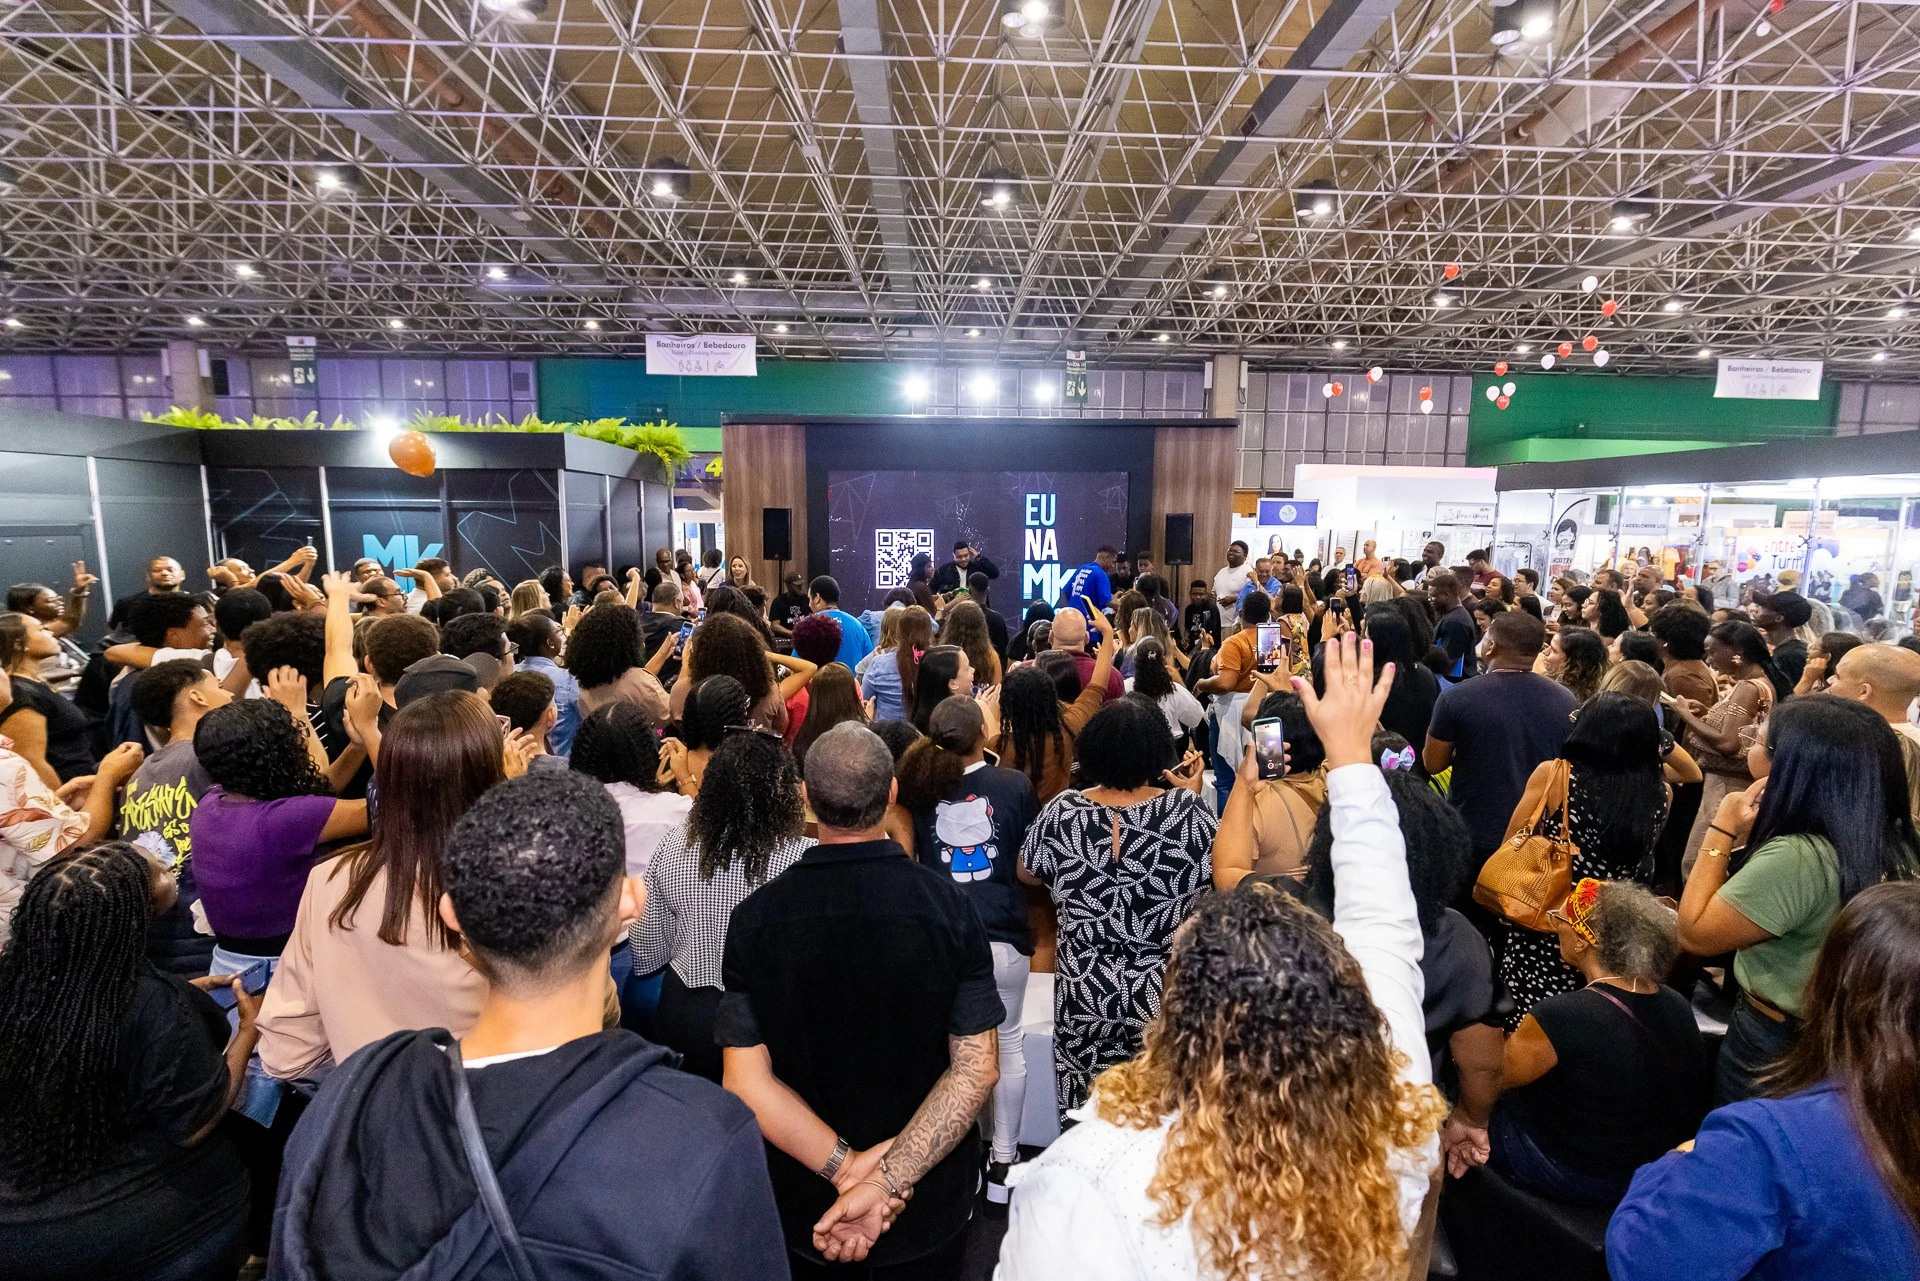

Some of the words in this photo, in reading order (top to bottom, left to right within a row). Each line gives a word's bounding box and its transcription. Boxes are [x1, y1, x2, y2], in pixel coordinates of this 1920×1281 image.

[656, 340, 695, 349] Banheiros
[703, 341, 746, 349] Bebedouro
[1727, 364, 1764, 372] Banheiros
[1771, 366, 1812, 374] Bebedouro
[1025, 493, 1057, 526] EU
[1024, 528, 1059, 561] NA
[362, 534, 444, 594] MK
[1771, 554, 1804, 570] Turm
[1023, 563, 1077, 609] MK
